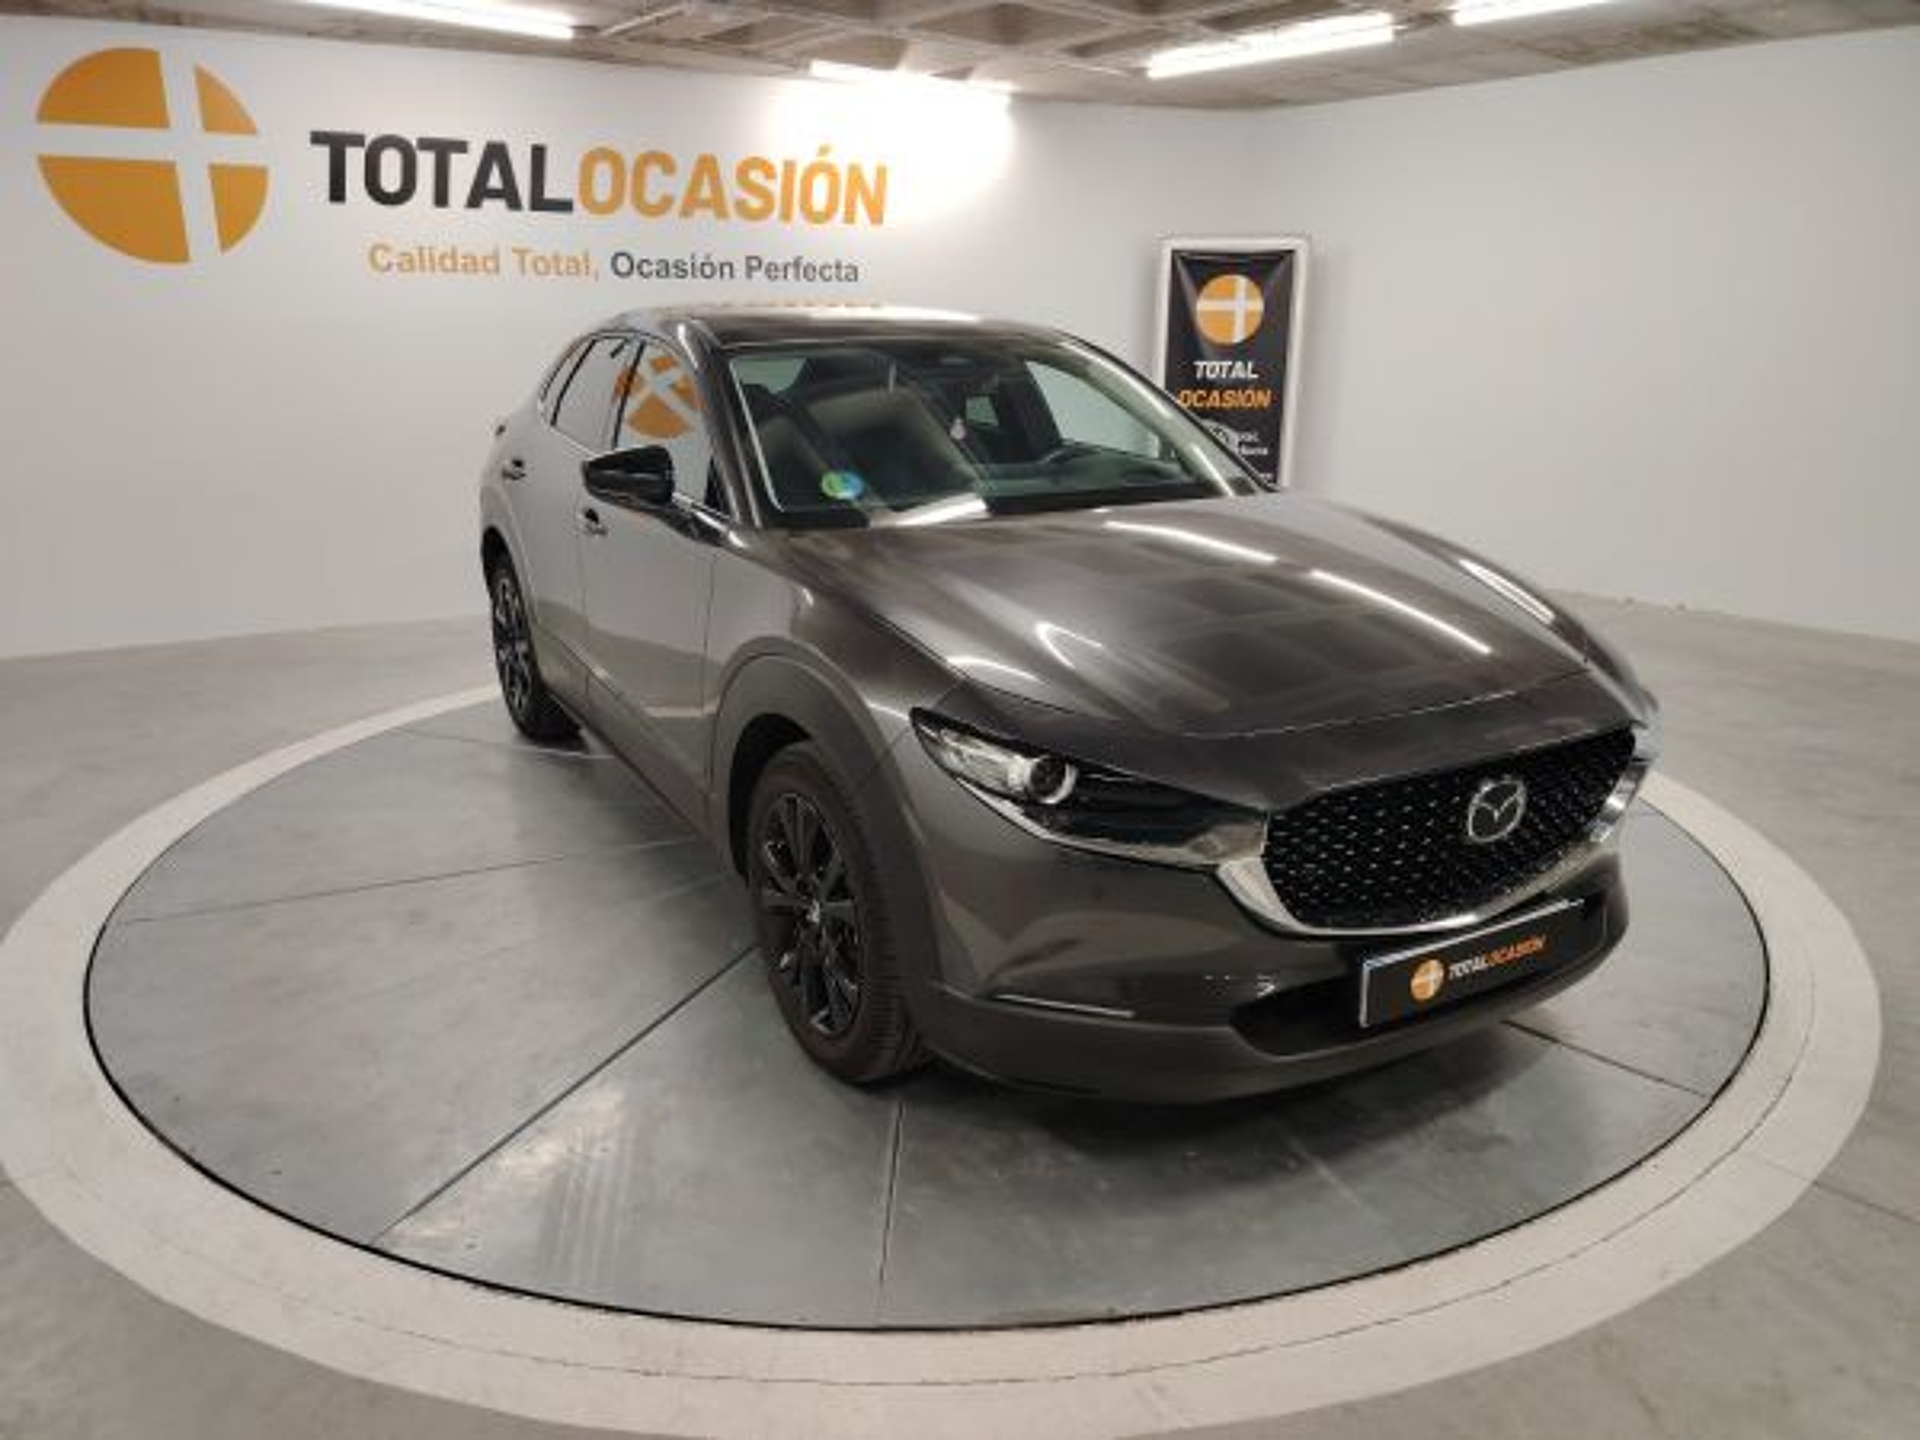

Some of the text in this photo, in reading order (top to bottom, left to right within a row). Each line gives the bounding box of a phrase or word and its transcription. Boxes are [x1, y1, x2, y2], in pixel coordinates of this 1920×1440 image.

[368, 243, 859, 283] Calidad Total, Ocasión Perfecta
[1193, 361, 1259, 379] TOTAL
